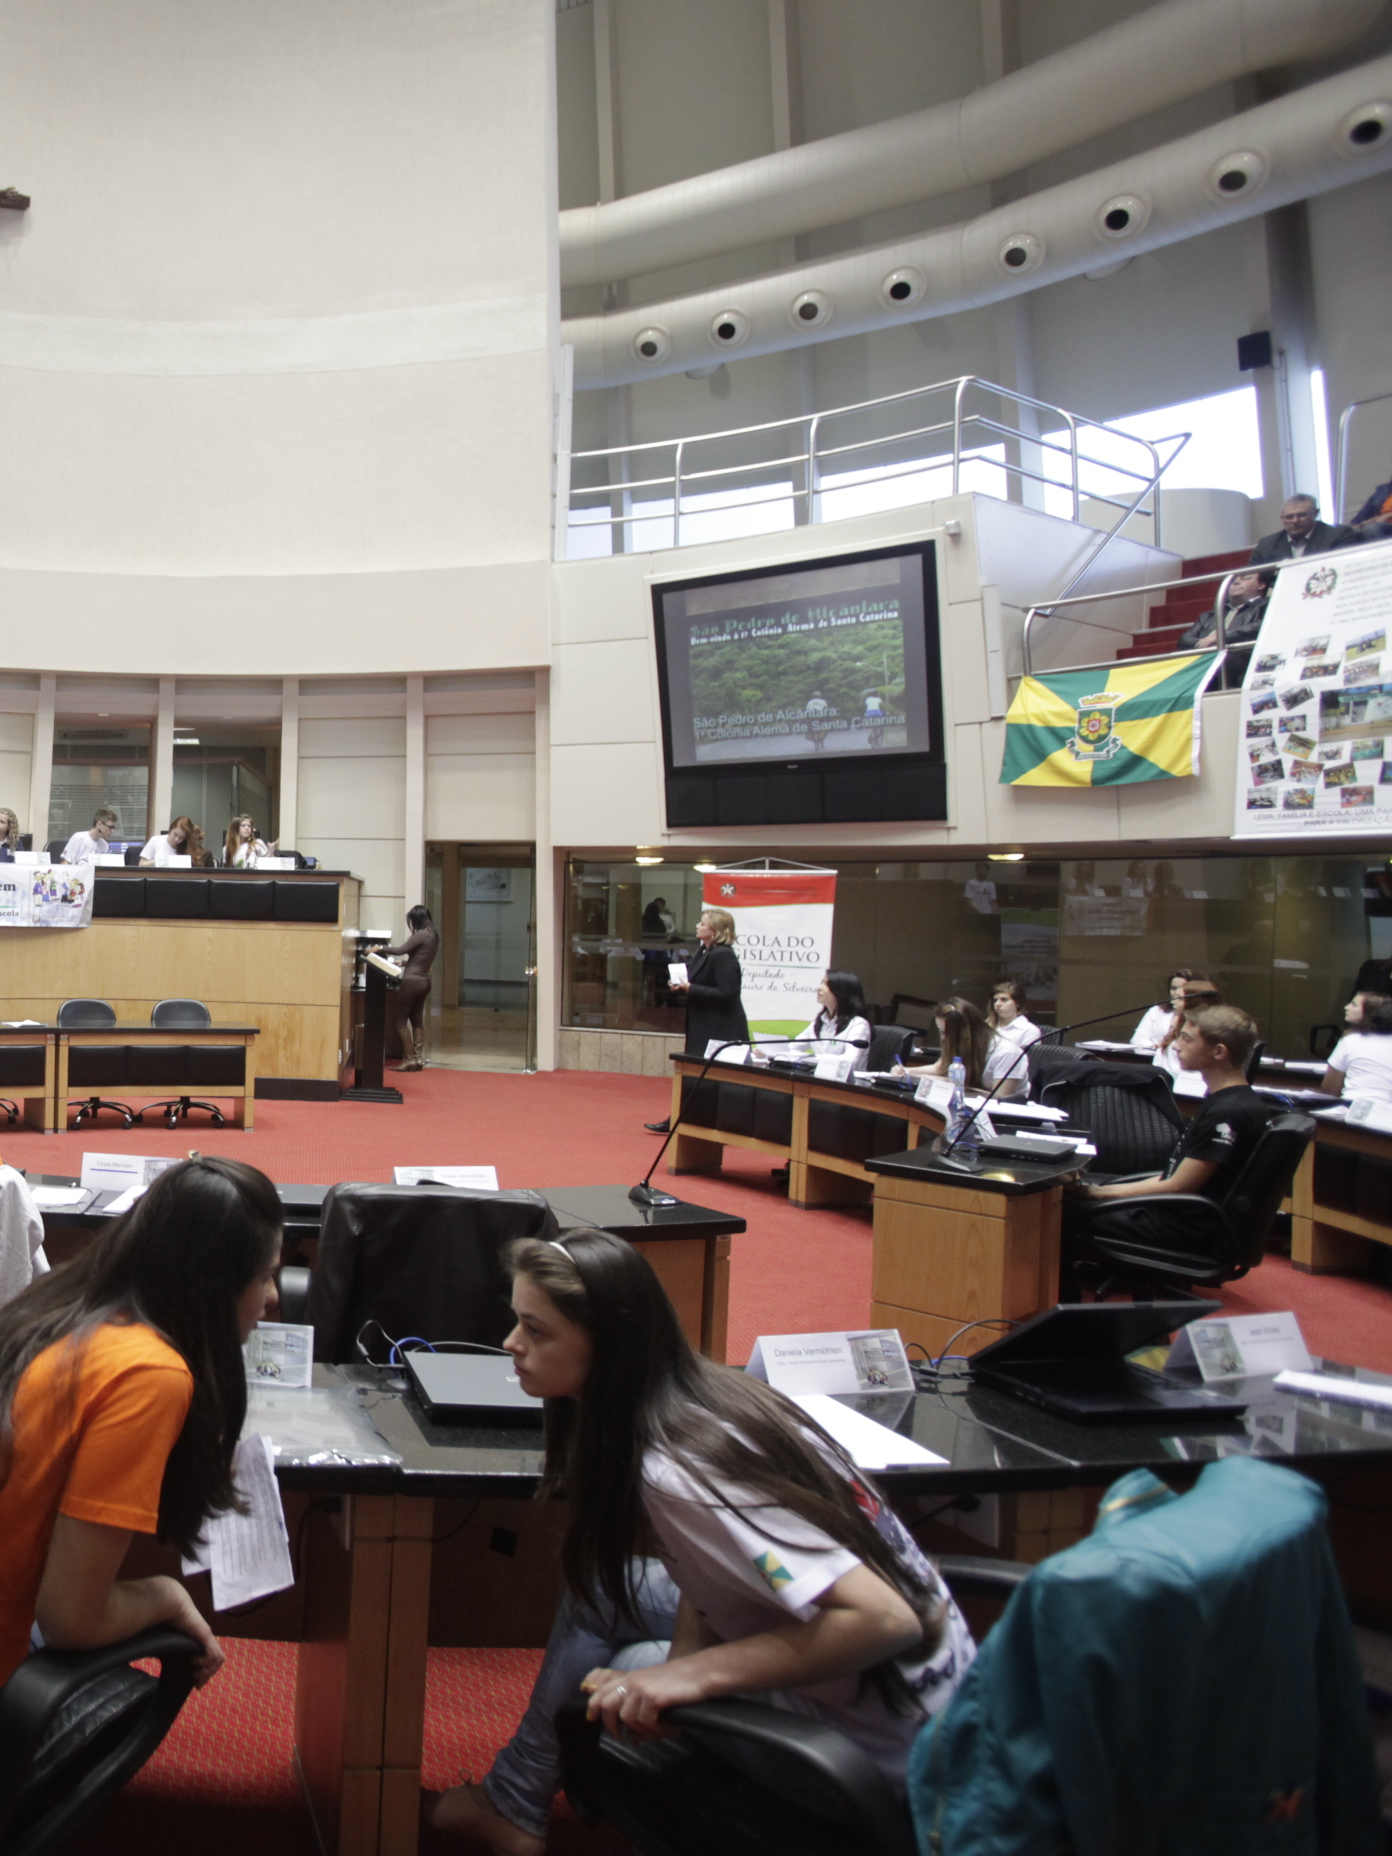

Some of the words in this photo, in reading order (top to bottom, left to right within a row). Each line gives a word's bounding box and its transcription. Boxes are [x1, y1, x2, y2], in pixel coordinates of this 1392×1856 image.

[690, 632, 731, 646] Bem-vindo
[751, 624, 783, 638] Colônia
[787, 622, 815, 633] Alemã
[818, 618, 828, 629] de
[830, 616, 856, 627] Santa
[858, 610, 898, 623] Catarina
[693, 717, 716, 729] São
[719, 714, 754, 727] Pedro
[758, 712, 773, 723] de
[709, 727, 750, 740] Colônia
[753, 723, 789, 736] Alemã
[792, 722, 808, 733] de
[811, 719, 848, 732] Santa
[851, 713, 906, 728] Catarina
[1354, 808, 1374, 816] UMA
[736, 934, 782, 947] COLA
[787, 935, 815, 949] DO
[767, 981, 779, 991] da
[774, 1347, 802, 1358] Daniela
[802, 1346, 843, 1357] Vermöhlen
